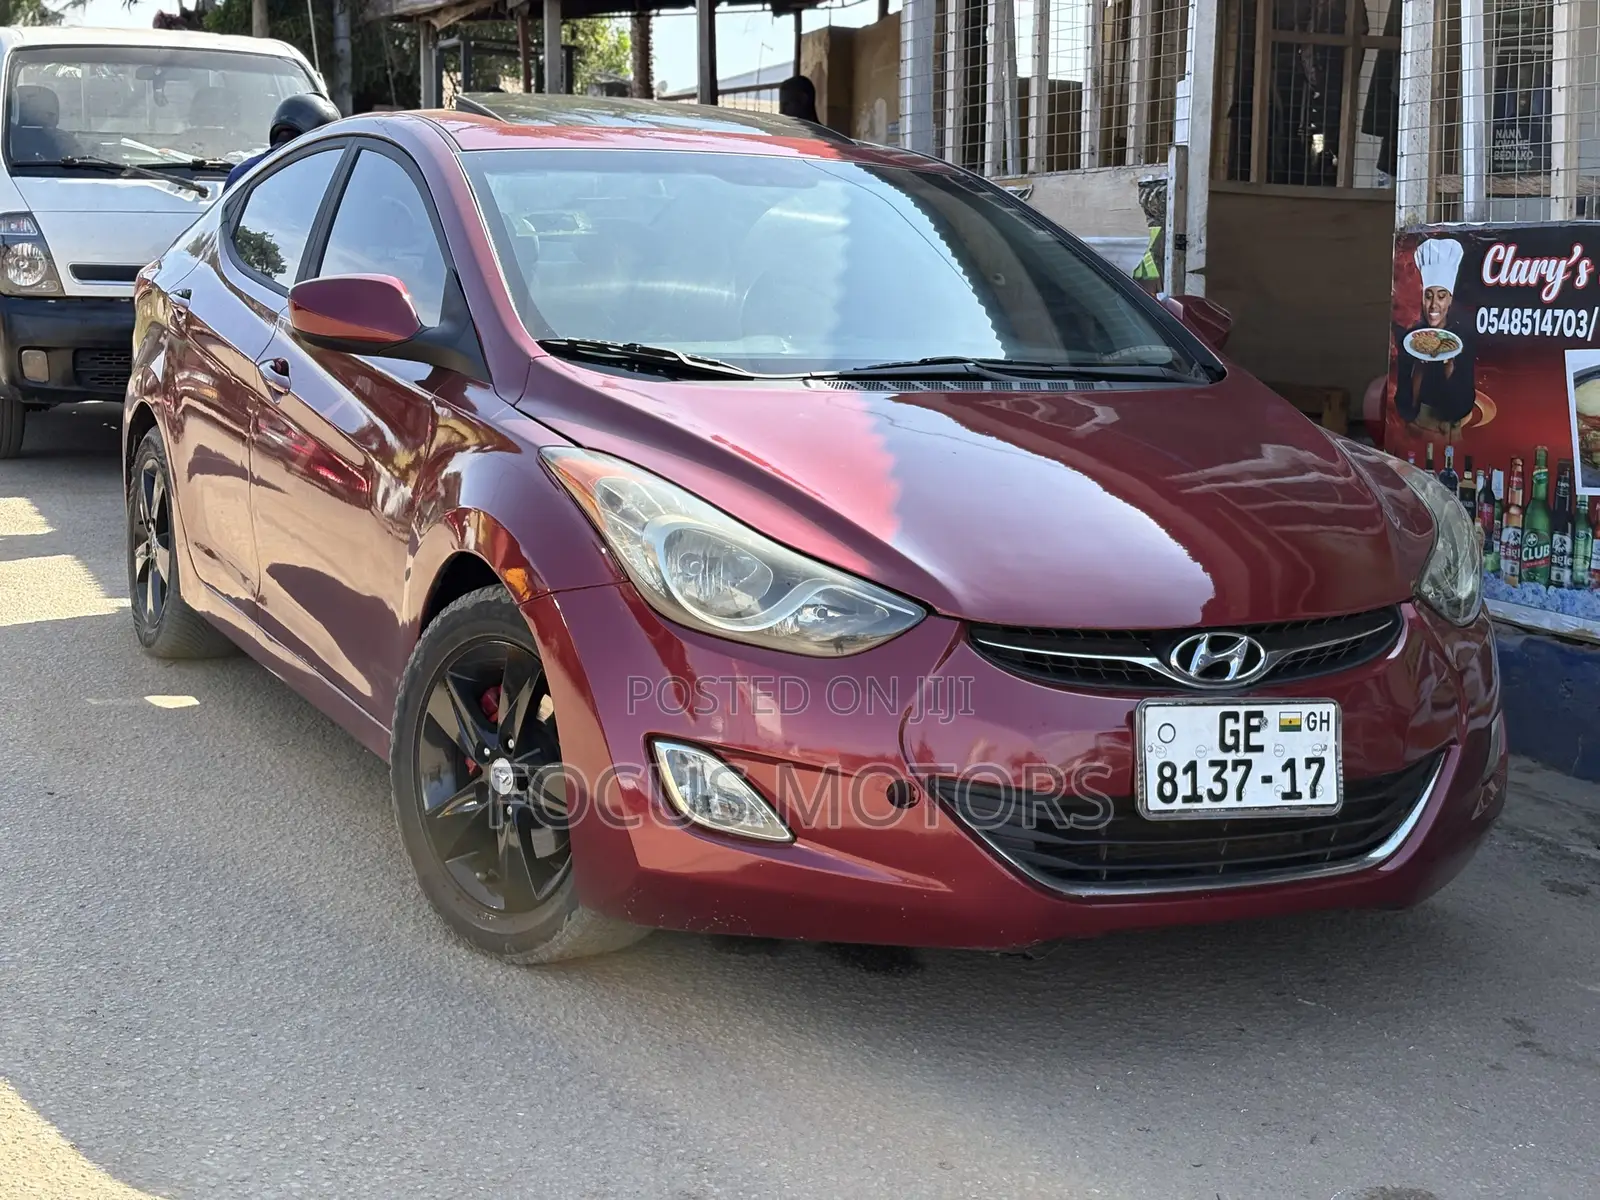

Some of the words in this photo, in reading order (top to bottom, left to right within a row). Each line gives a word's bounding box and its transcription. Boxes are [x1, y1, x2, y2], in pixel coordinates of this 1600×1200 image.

[1496, 129, 1521, 139] NANA
[1494, 150, 1533, 160] BEDIAKO
[1482, 244, 1594, 302] Clary's
[1500, 545, 1520, 560] Eagl
[1522, 544, 1550, 561] CLUB
[1551, 554, 1573, 567] agle
[1219, 710, 1264, 754] GE
[1306, 711, 1330, 732] GH
